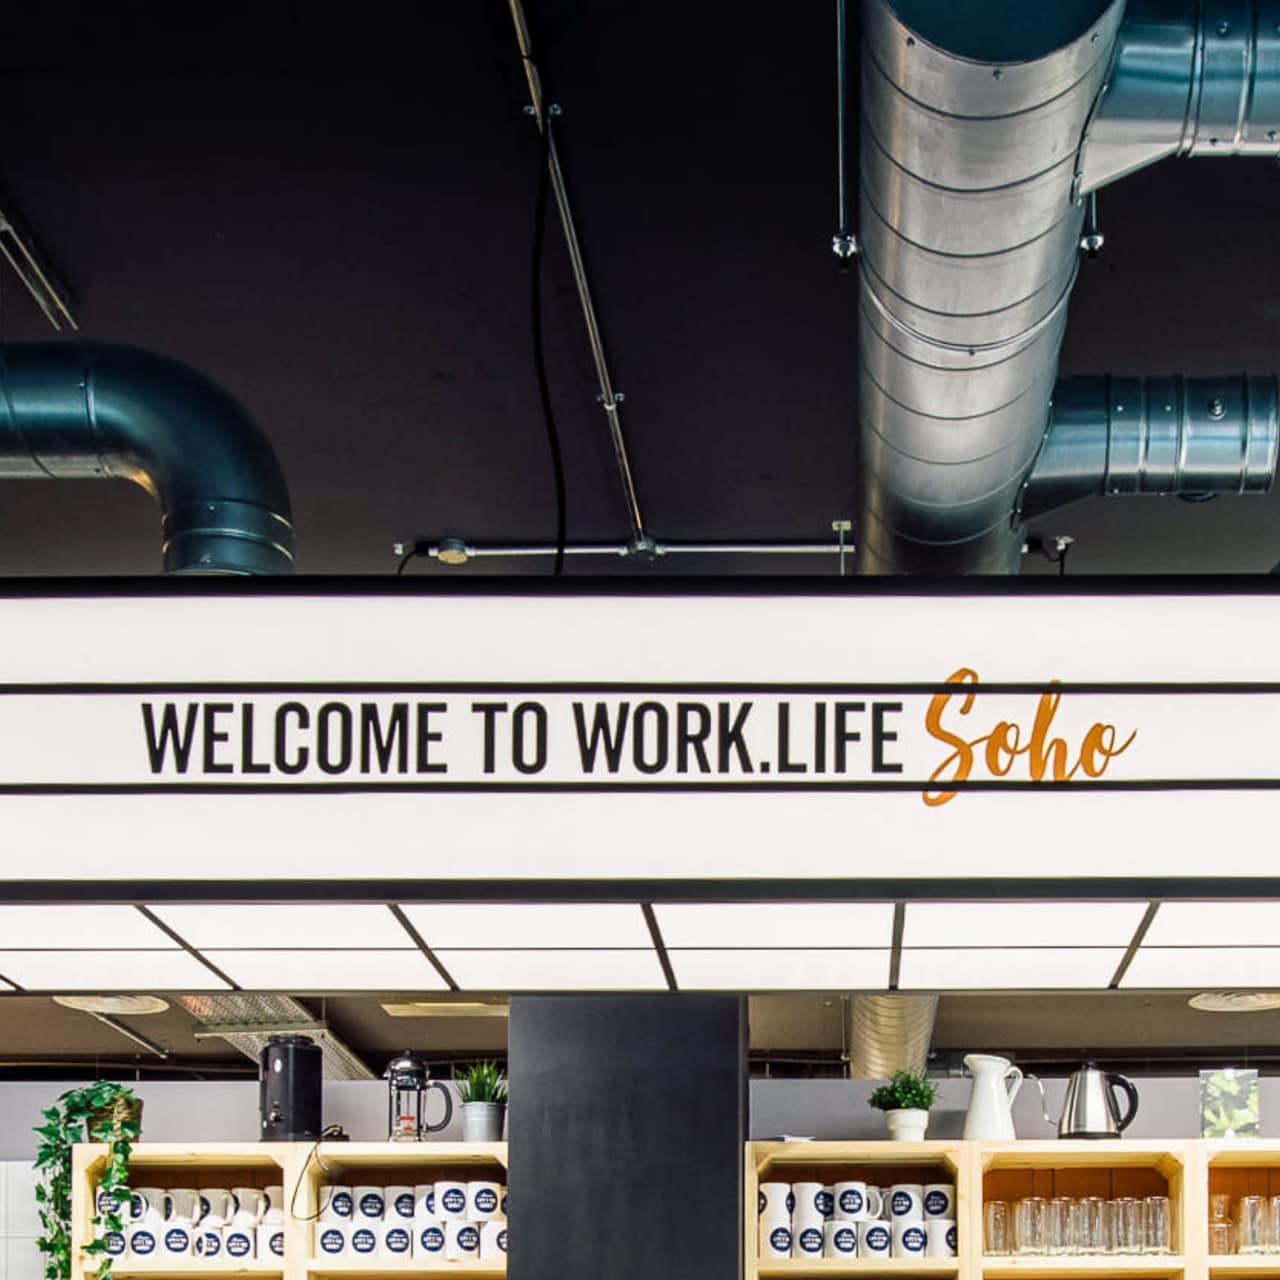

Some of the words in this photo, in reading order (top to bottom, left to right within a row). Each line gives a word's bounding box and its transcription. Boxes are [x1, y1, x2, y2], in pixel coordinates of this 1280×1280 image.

[141, 703, 447, 773] WELCOME
[471, 703, 547, 773] TO
[572, 703, 902, 773] WORK.LIFE
[921, 667, 1137, 807] Soho
